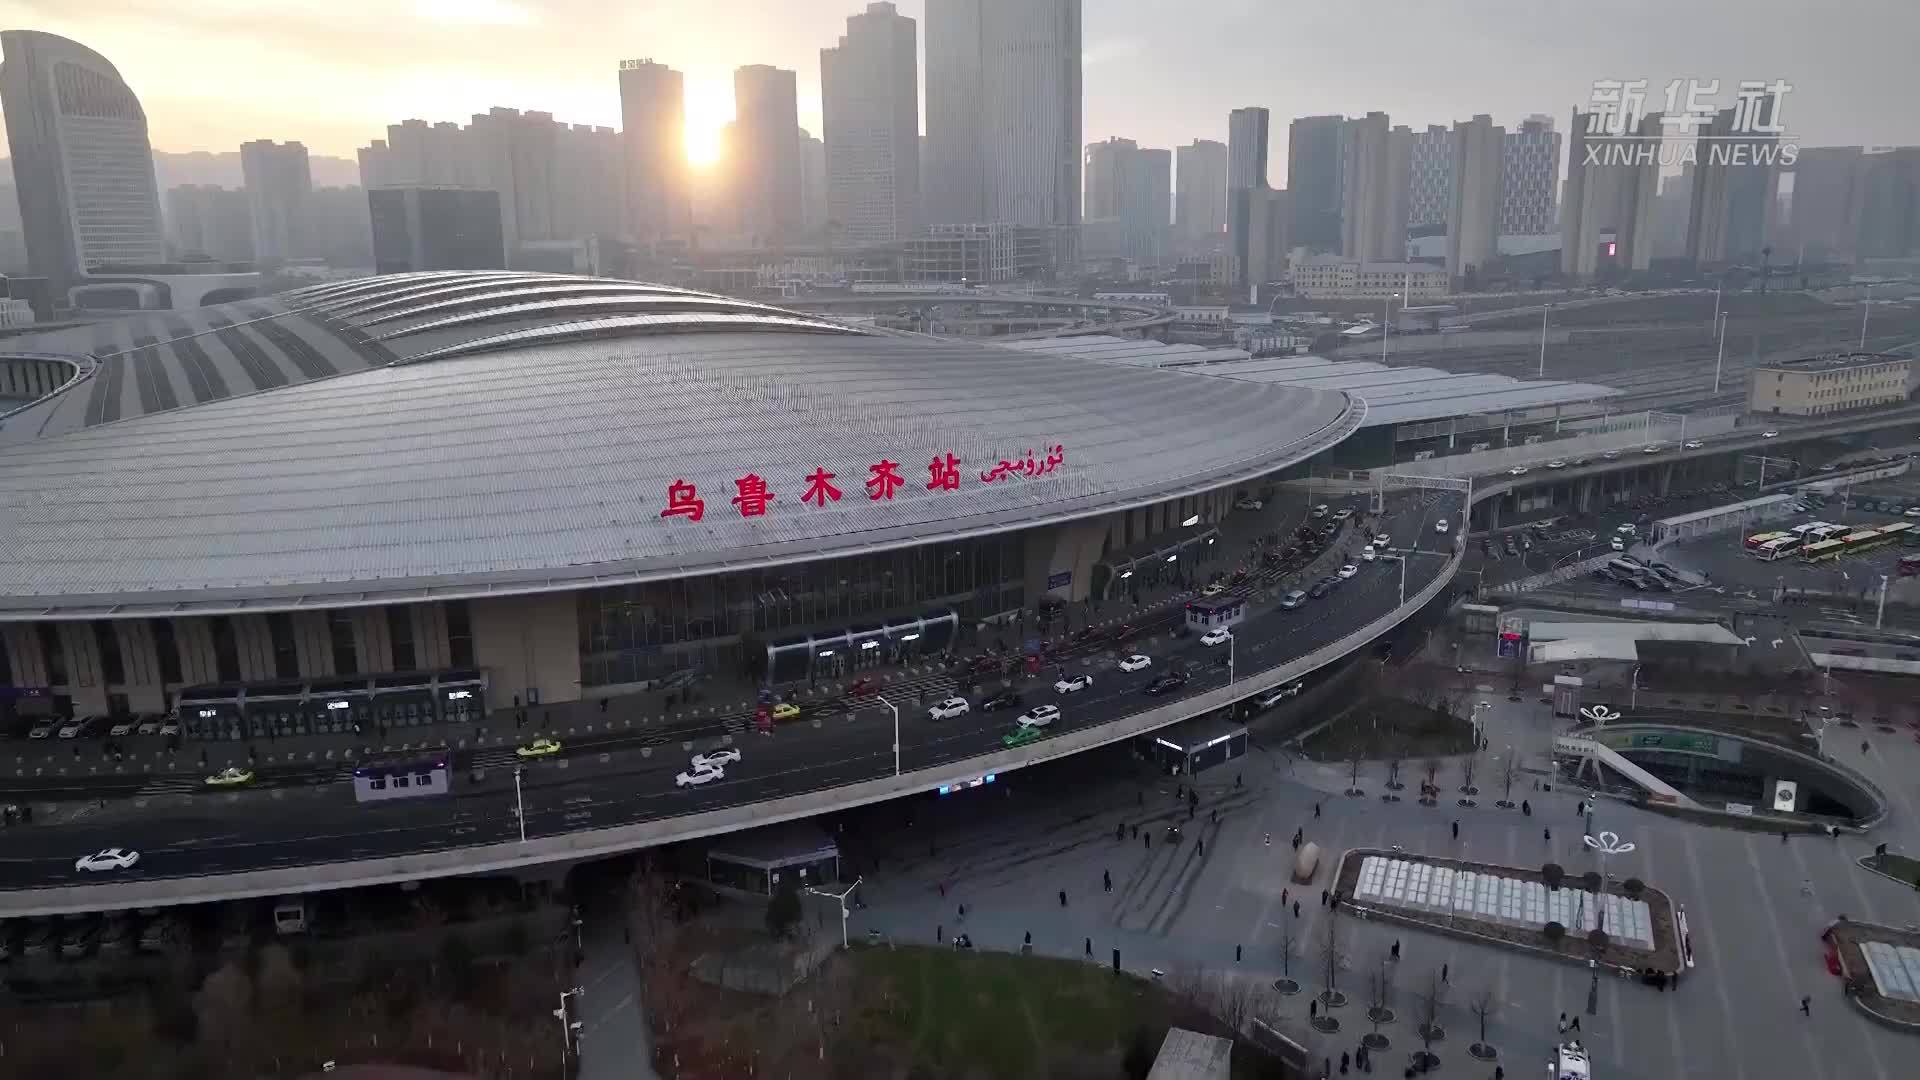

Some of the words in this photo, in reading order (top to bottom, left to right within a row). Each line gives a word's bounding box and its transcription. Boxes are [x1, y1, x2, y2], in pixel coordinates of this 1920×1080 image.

[661, 453, 961, 521] 乌鲁木齐站
